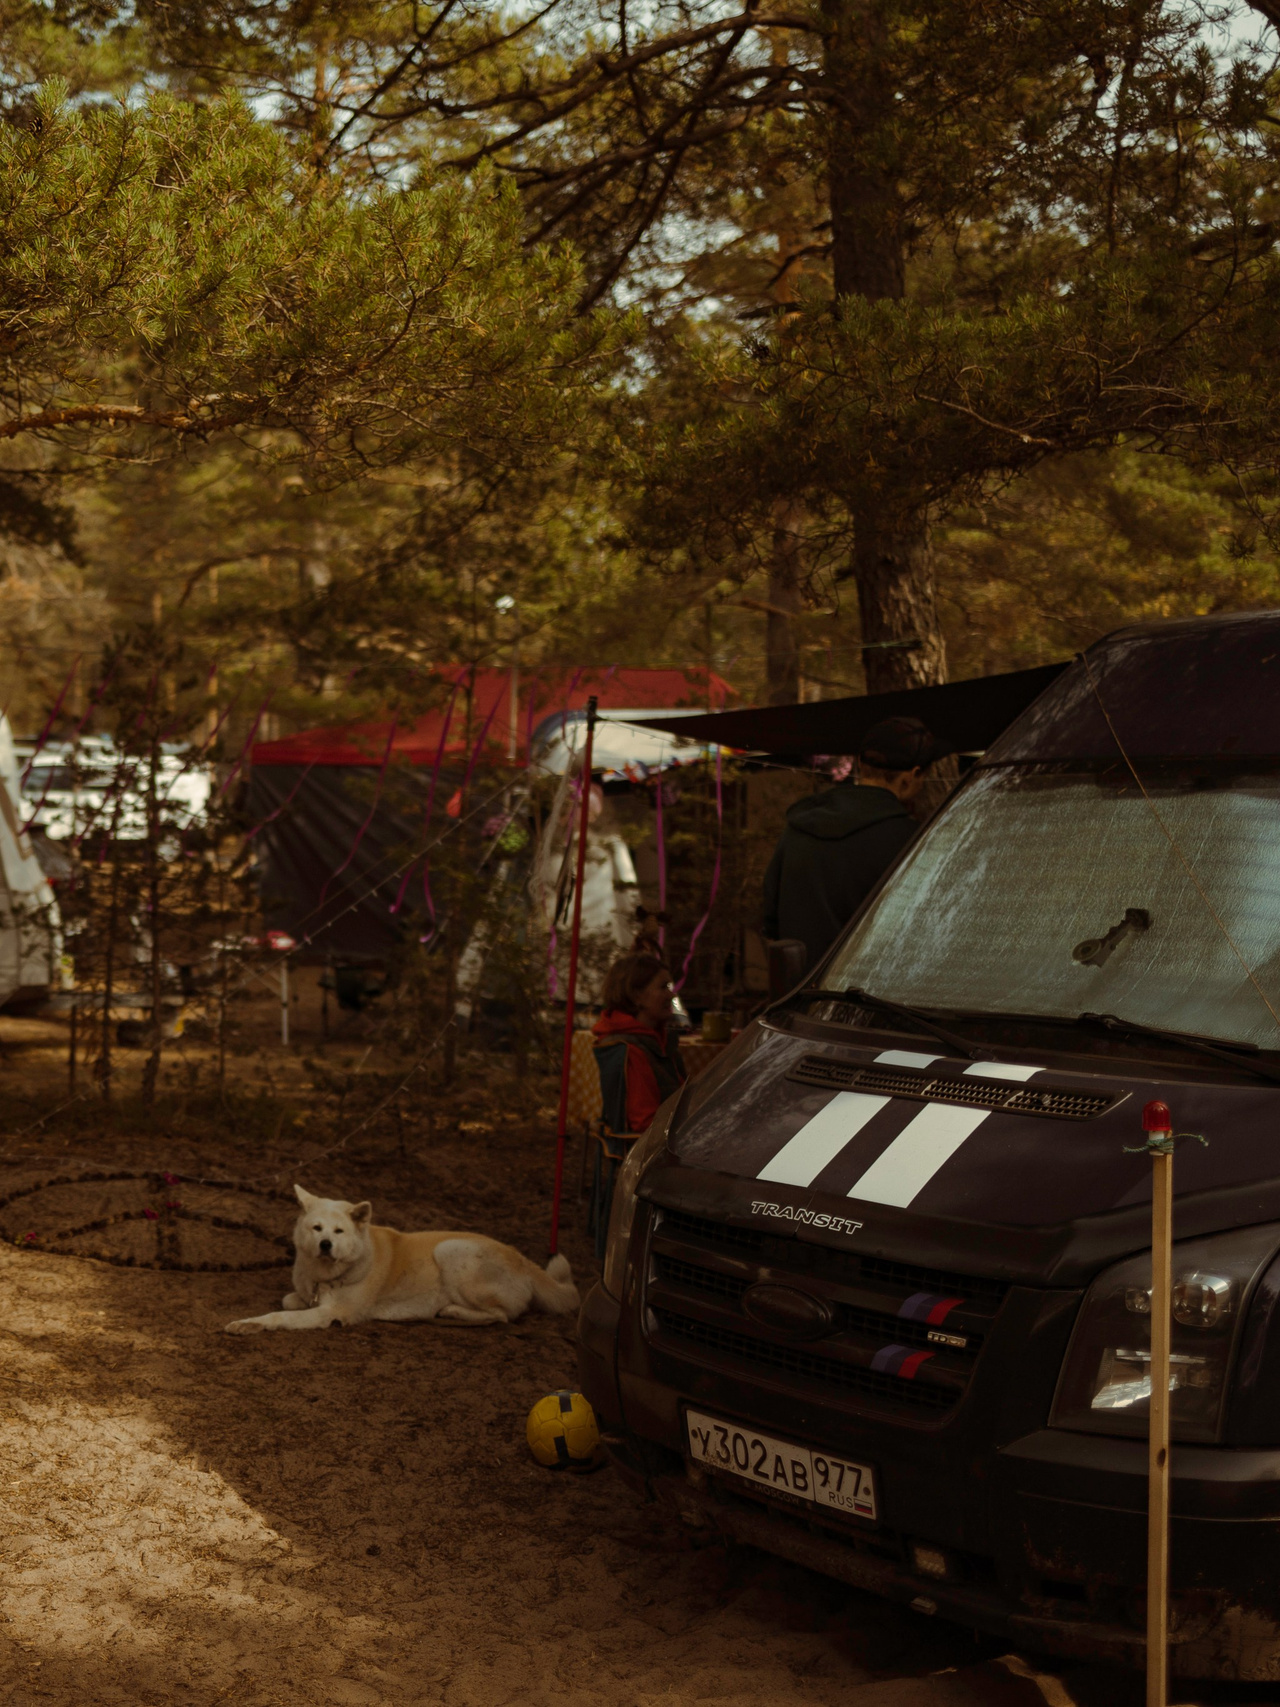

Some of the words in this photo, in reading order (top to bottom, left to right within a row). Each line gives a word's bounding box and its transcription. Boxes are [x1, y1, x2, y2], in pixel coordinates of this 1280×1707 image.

[751, 1201, 863, 1235] TRANSIT
[814, 1456, 863, 1498] 977
[828, 1491, 854, 1509] RUS
